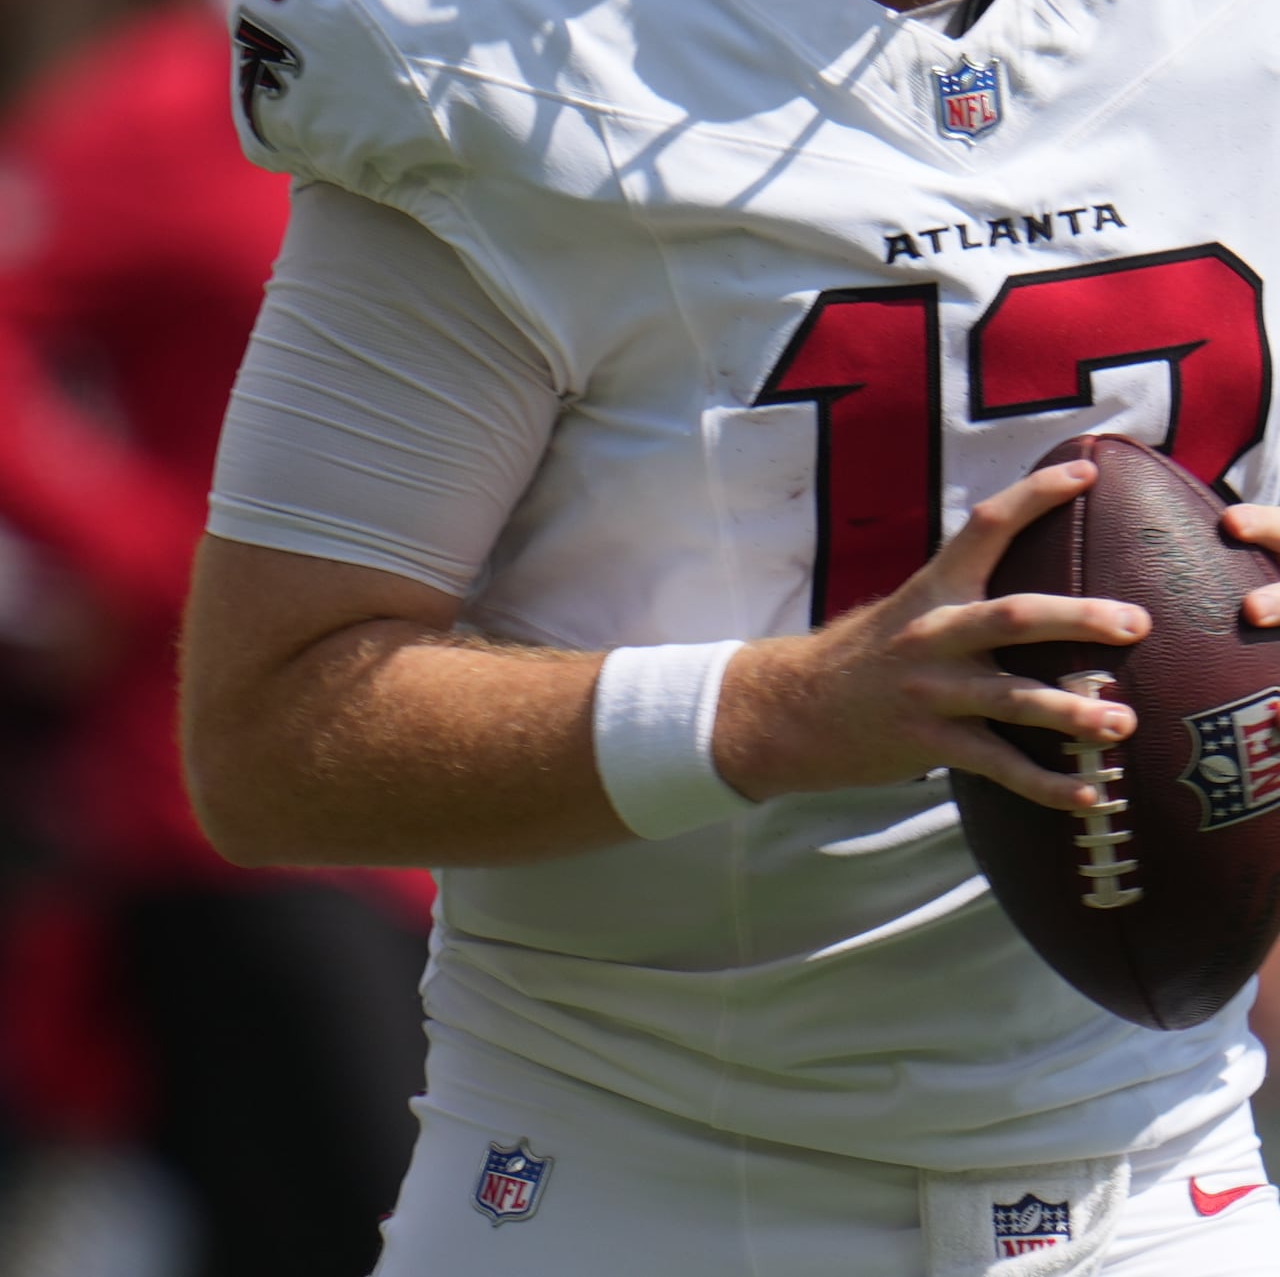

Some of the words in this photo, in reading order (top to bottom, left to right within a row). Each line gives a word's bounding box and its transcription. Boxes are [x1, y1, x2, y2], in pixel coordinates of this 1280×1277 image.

[946, 93, 997, 128] NFL
[885, 203, 1128, 265] ATLANTA
[481, 1172, 530, 1210] NFL
